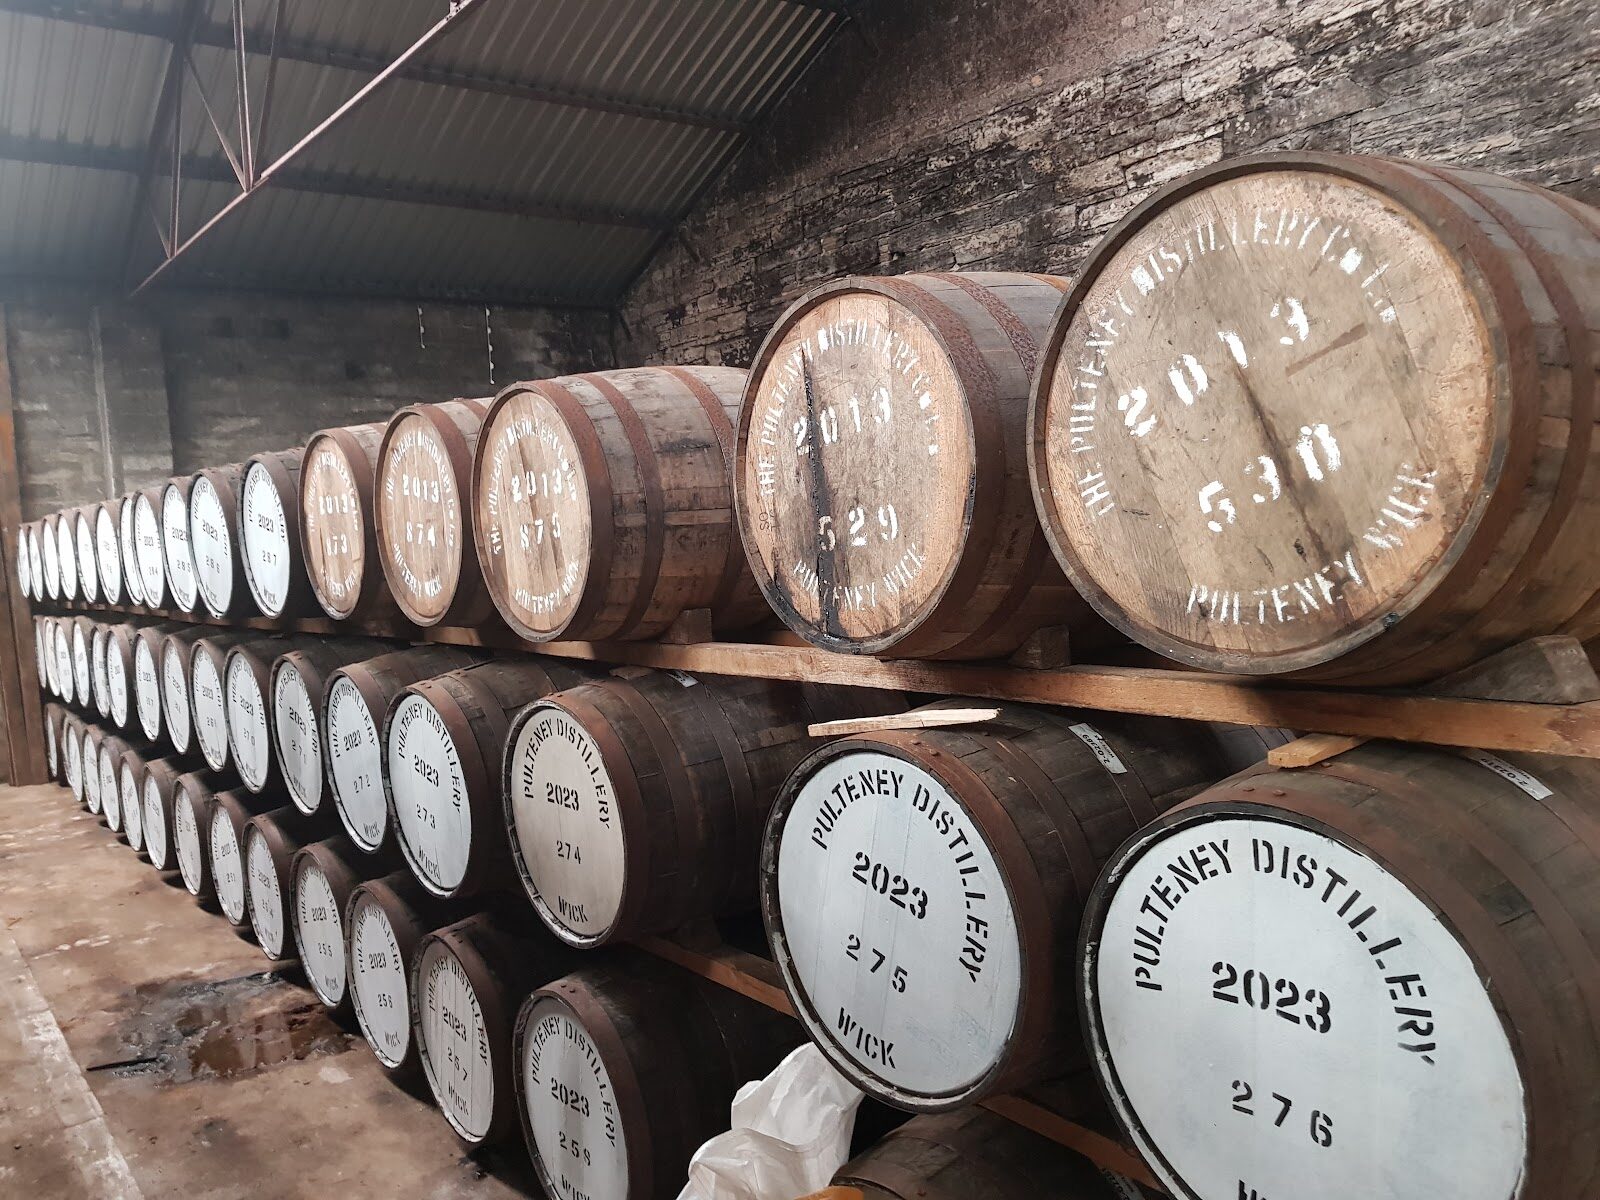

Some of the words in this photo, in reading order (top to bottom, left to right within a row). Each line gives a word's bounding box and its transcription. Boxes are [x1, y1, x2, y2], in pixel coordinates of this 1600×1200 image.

[1117, 296, 1309, 437] 2013
[792, 387, 891, 456] 2013
[402, 473, 440, 504] 2013
[511, 468, 562, 503] 2013
[758, 450, 776, 498] THE
[1198, 422, 1342, 533] 530
[406, 521, 437, 547] 874
[818, 502, 899, 552] 529
[343, 729, 363, 752] 2023
[398, 703, 424, 760] PULTENEY
[426, 706, 461, 815] DISTILLERY
[353, 774, 372, 794] 272
[414, 754, 440, 789] 2023
[524, 718, 553, 799] PULTENEY
[556, 717, 611, 830] DISTILLERY
[546, 781, 580, 812] 2023
[416, 803, 437, 830] 273
[418, 844, 441, 881] WICK
[556, 839, 582, 865] 274
[811, 768, 904, 850] PULTENEY
[912, 783, 989, 983] DISTILLERY
[852, 851, 928, 920] 2023
[311, 906, 328, 922] 2023
[558, 895, 589, 924] WICK
[368, 952, 387, 970] 2023
[846, 934, 908, 993] 275
[1133, 838, 1233, 991] PULTENEY
[1252, 837, 1437, 1066] DISTILLERY
[377, 993, 393, 1009] 256
[428, 956, 448, 1012] PULTENEY
[451, 958, 489, 1067] DISTILLERY
[1212, 960, 1333, 1035] 2023
[442, 1005, 467, 1043] 2023
[838, 1006, 896, 1069] WICK
[447, 1046, 468, 1082] 257
[531, 1016, 561, 1085] PULTENEY
[565, 1019, 616, 1148] DISTILLERY
[448, 1080, 469, 1116] WICK
[551, 1077, 590, 1118] 2023
[1231, 1079, 1334, 1148] 276
